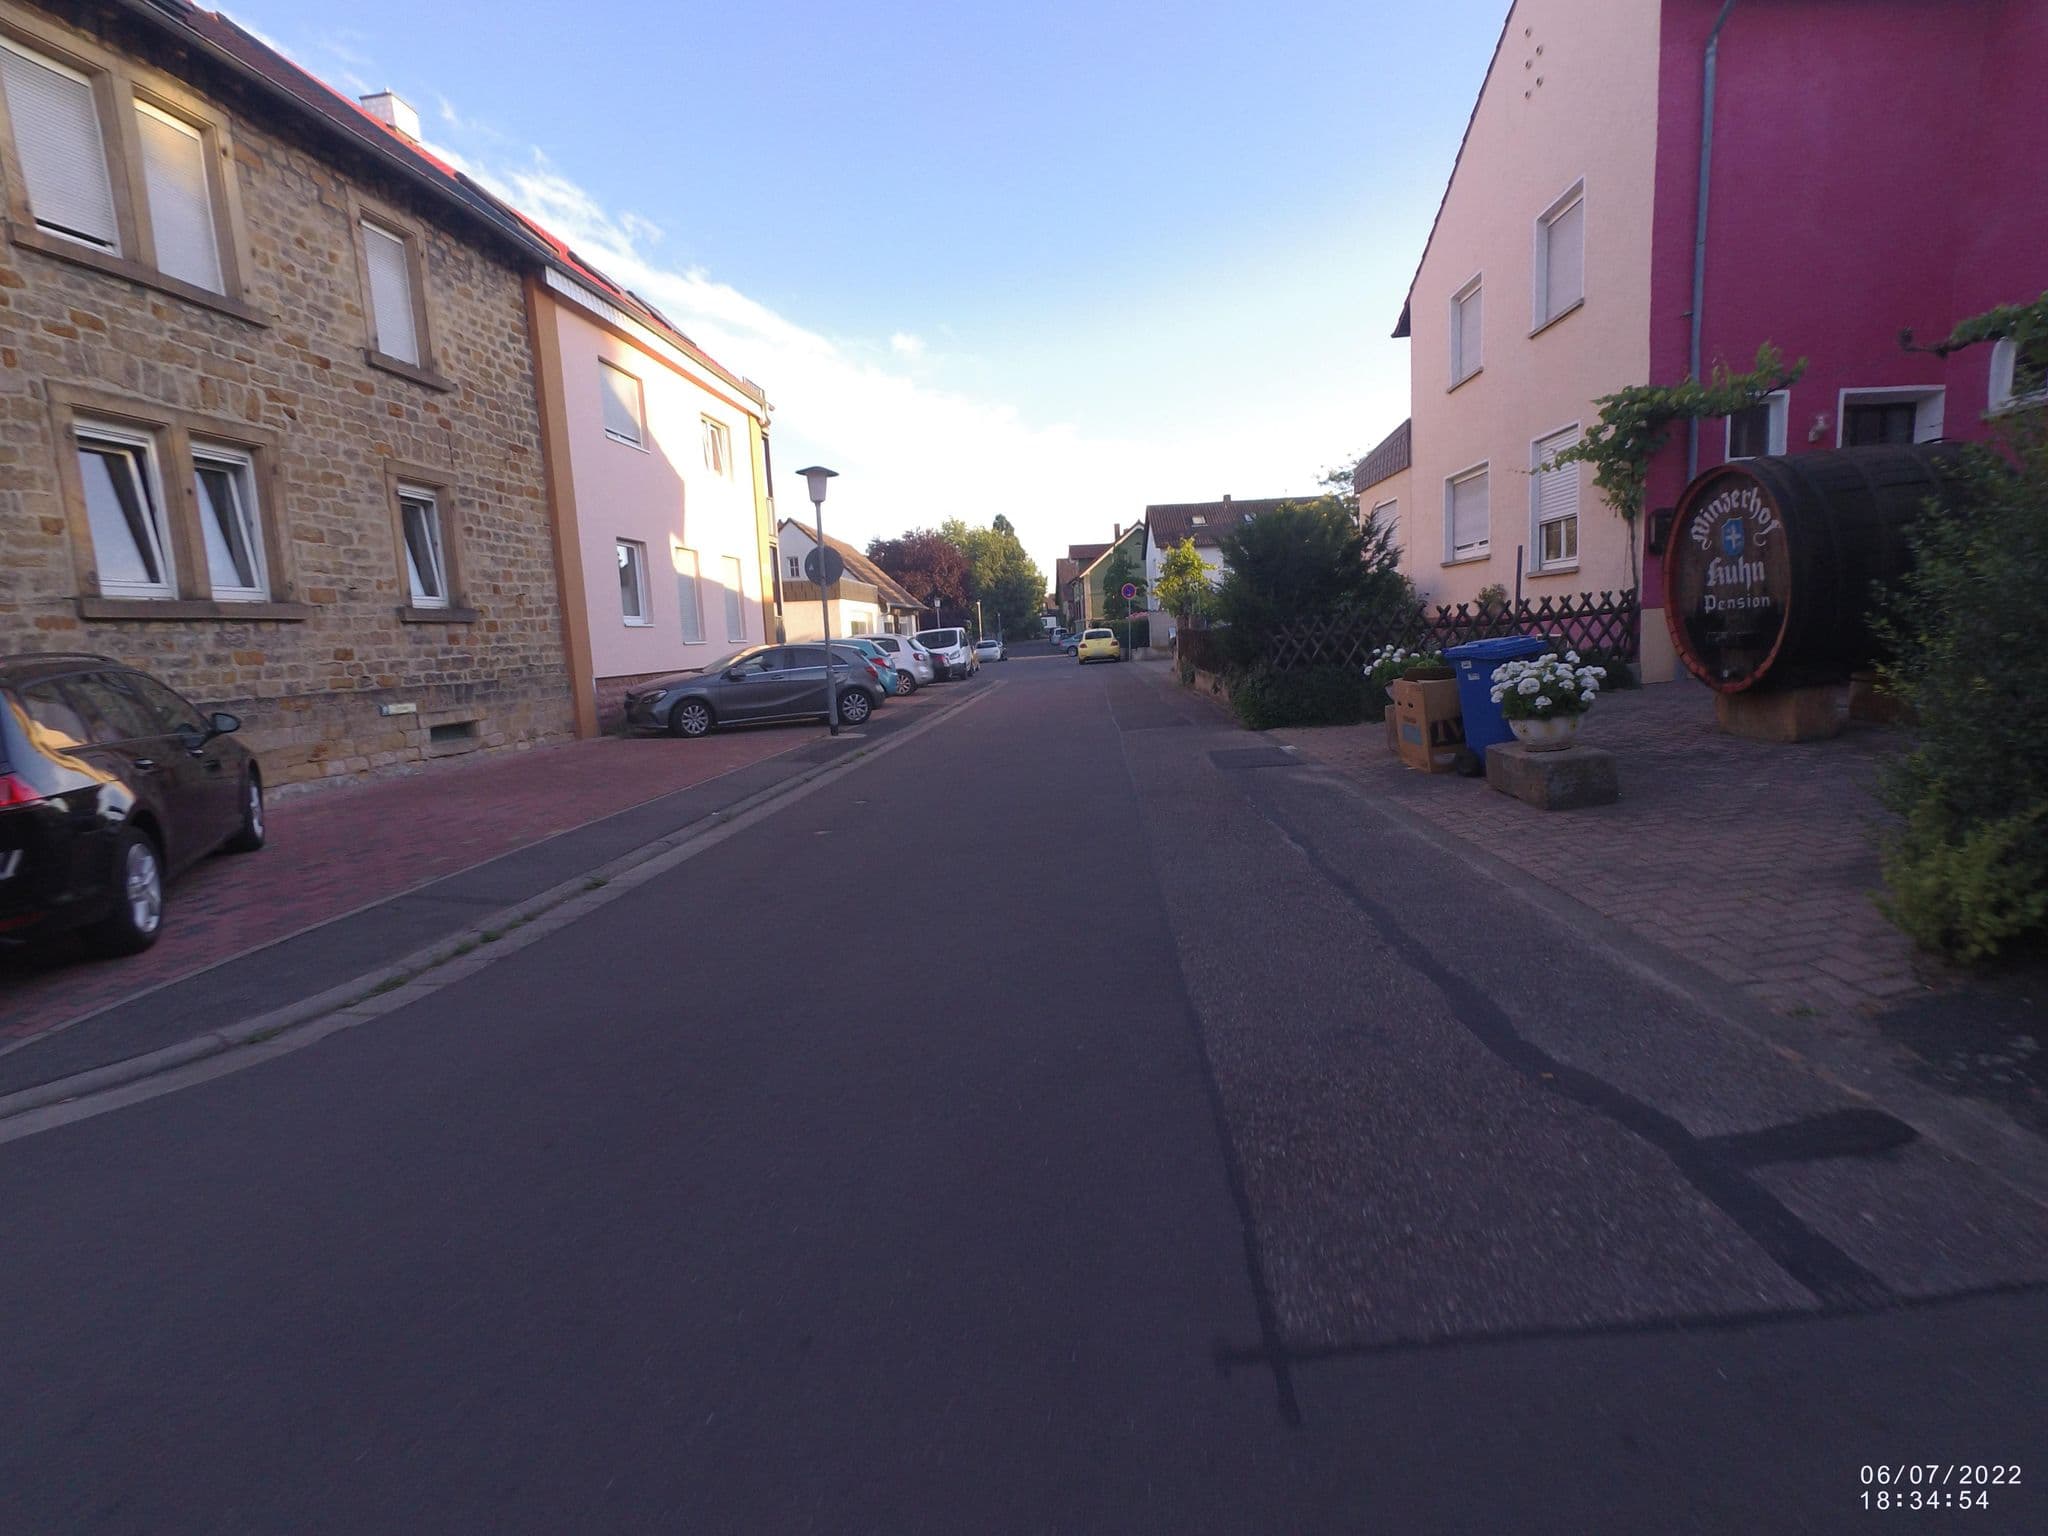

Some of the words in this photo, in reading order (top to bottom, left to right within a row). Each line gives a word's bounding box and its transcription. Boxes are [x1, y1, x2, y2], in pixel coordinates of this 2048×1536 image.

[1691, 487, 1781, 550] Winzerhof
[1706, 556, 1765, 590] Kuhn
[1704, 594, 1771, 613] Pension
